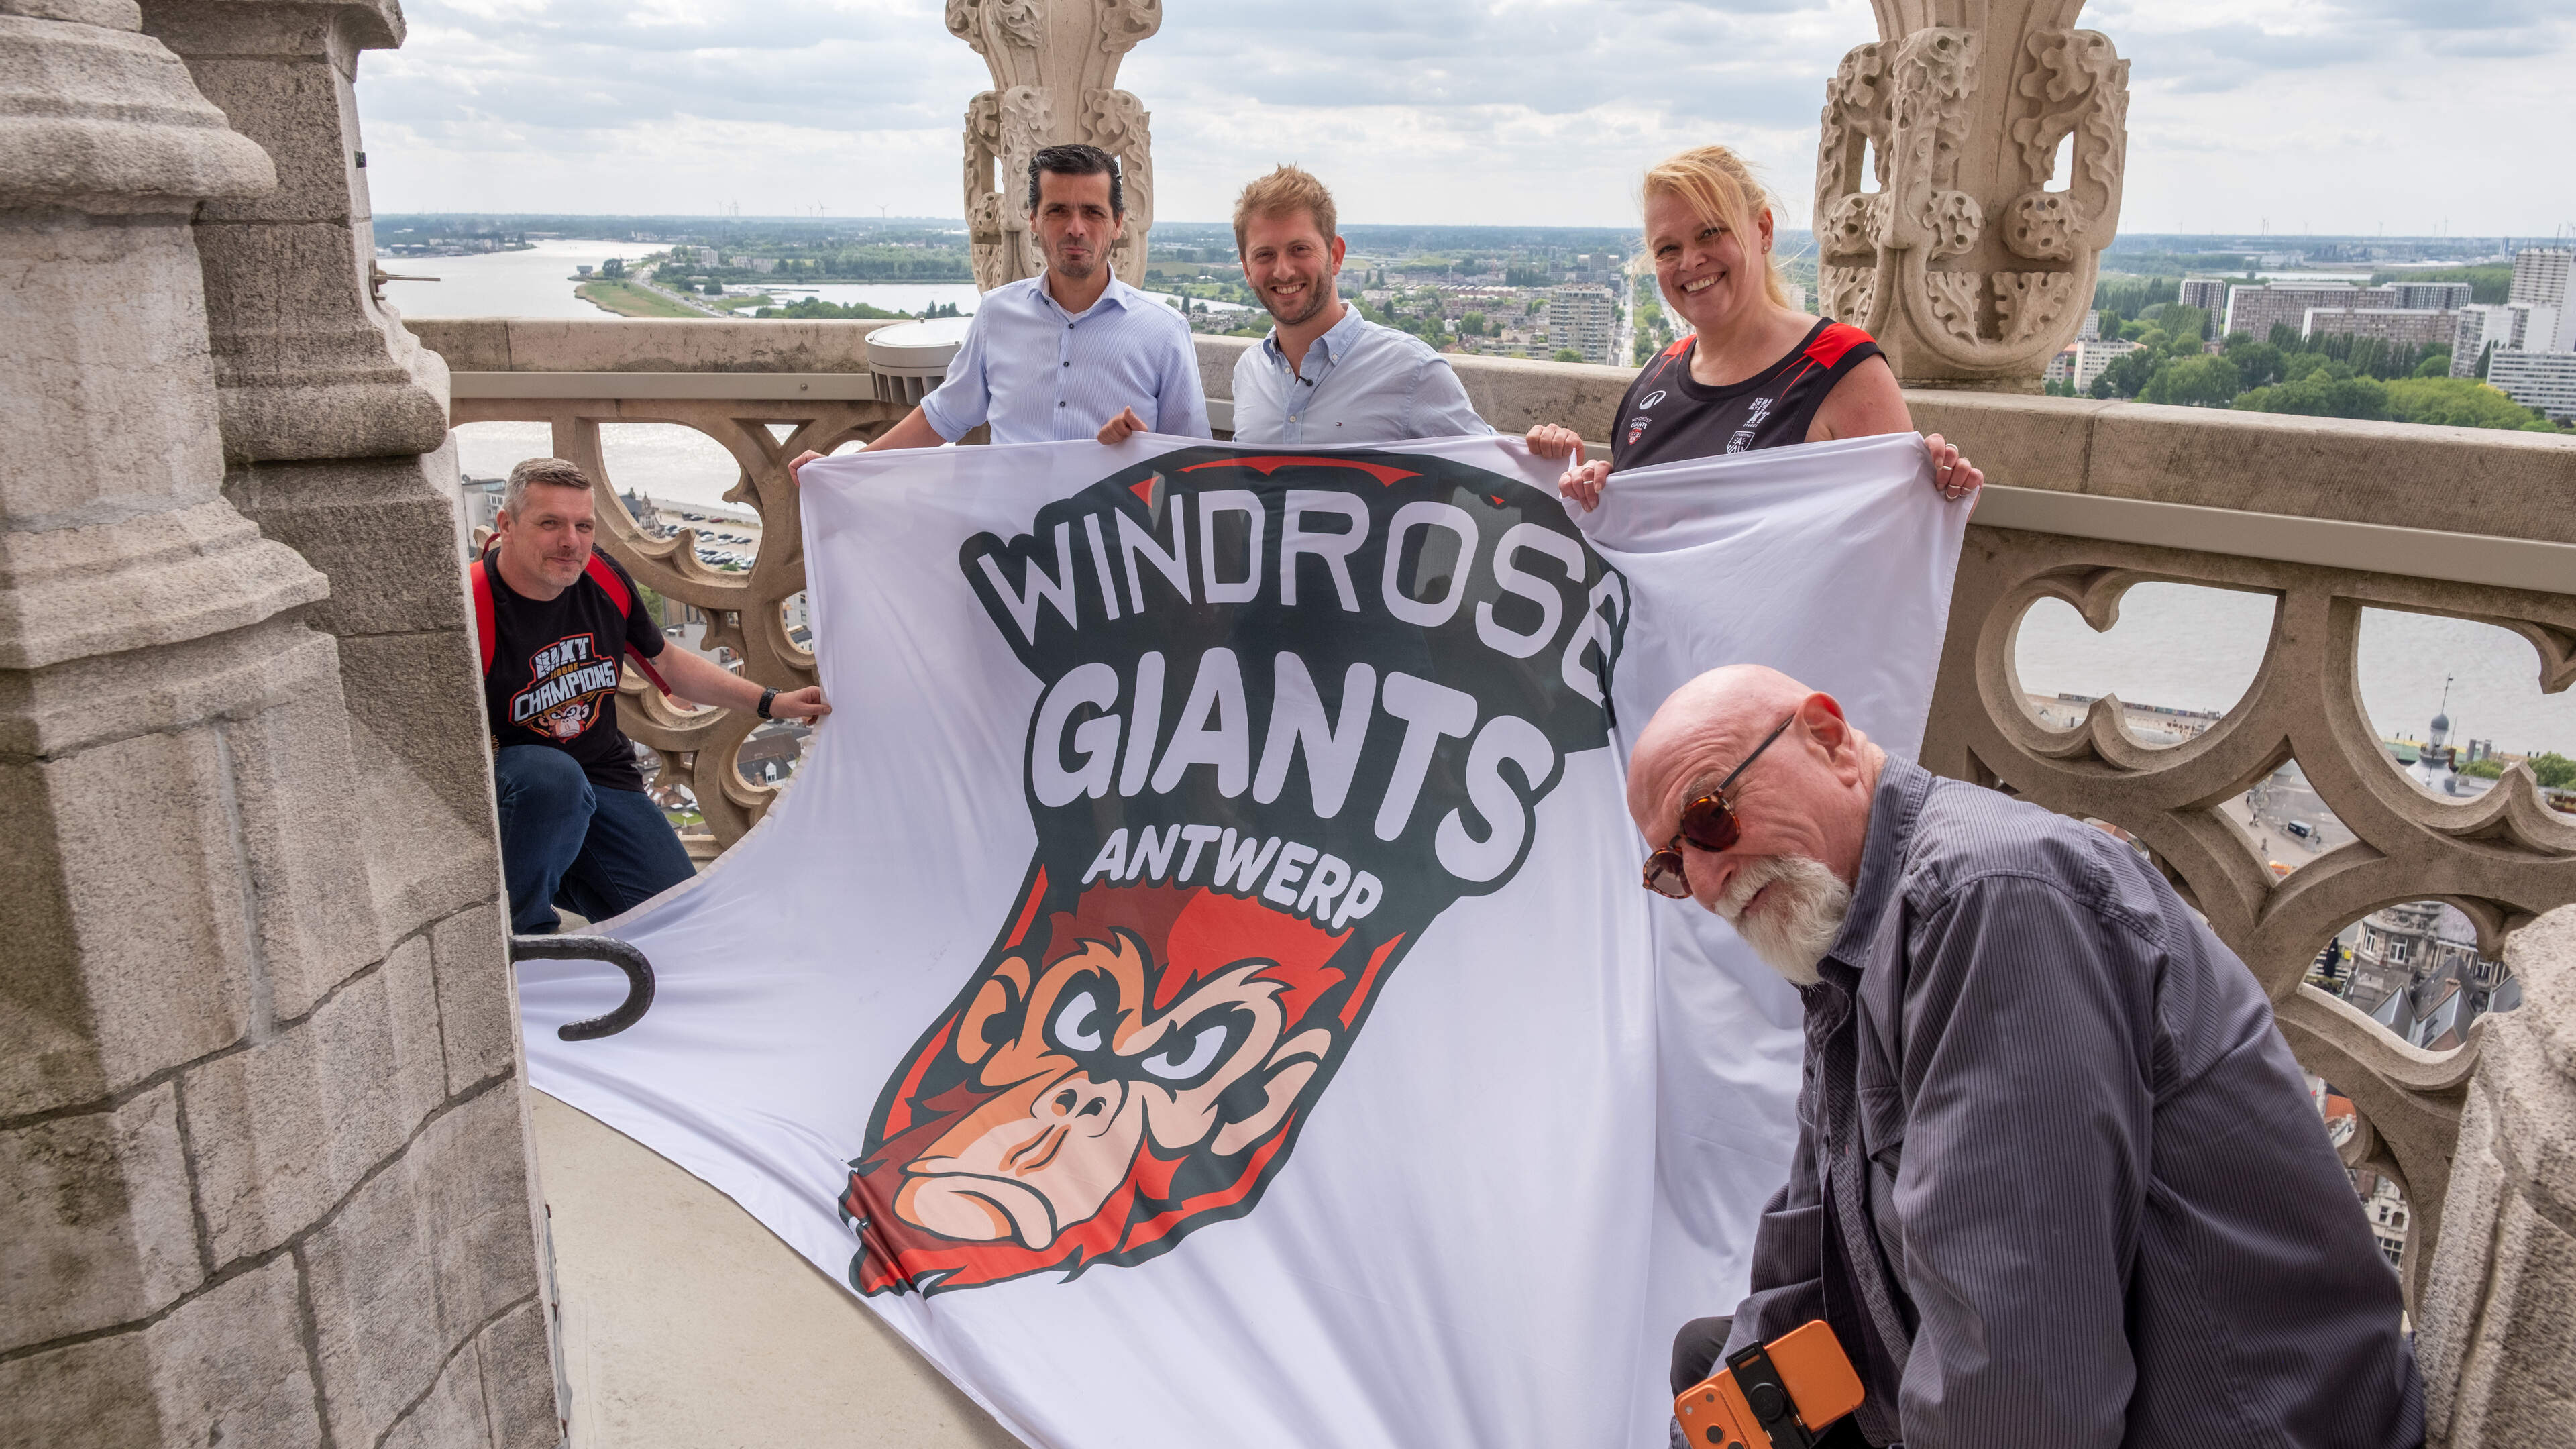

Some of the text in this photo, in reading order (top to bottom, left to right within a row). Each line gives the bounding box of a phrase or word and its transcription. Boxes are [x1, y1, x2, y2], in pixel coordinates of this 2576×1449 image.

[1630, 421, 1648, 429] GIANTS
[977, 490, 1624, 708] WINDROSE
[514, 661, 617, 722] CHAMPIONS
[549, 662, 580, 680] LEAGUE
[1032, 647, 1554, 883] GIANTS
[1082, 824, 1383, 930] ANTWERP
